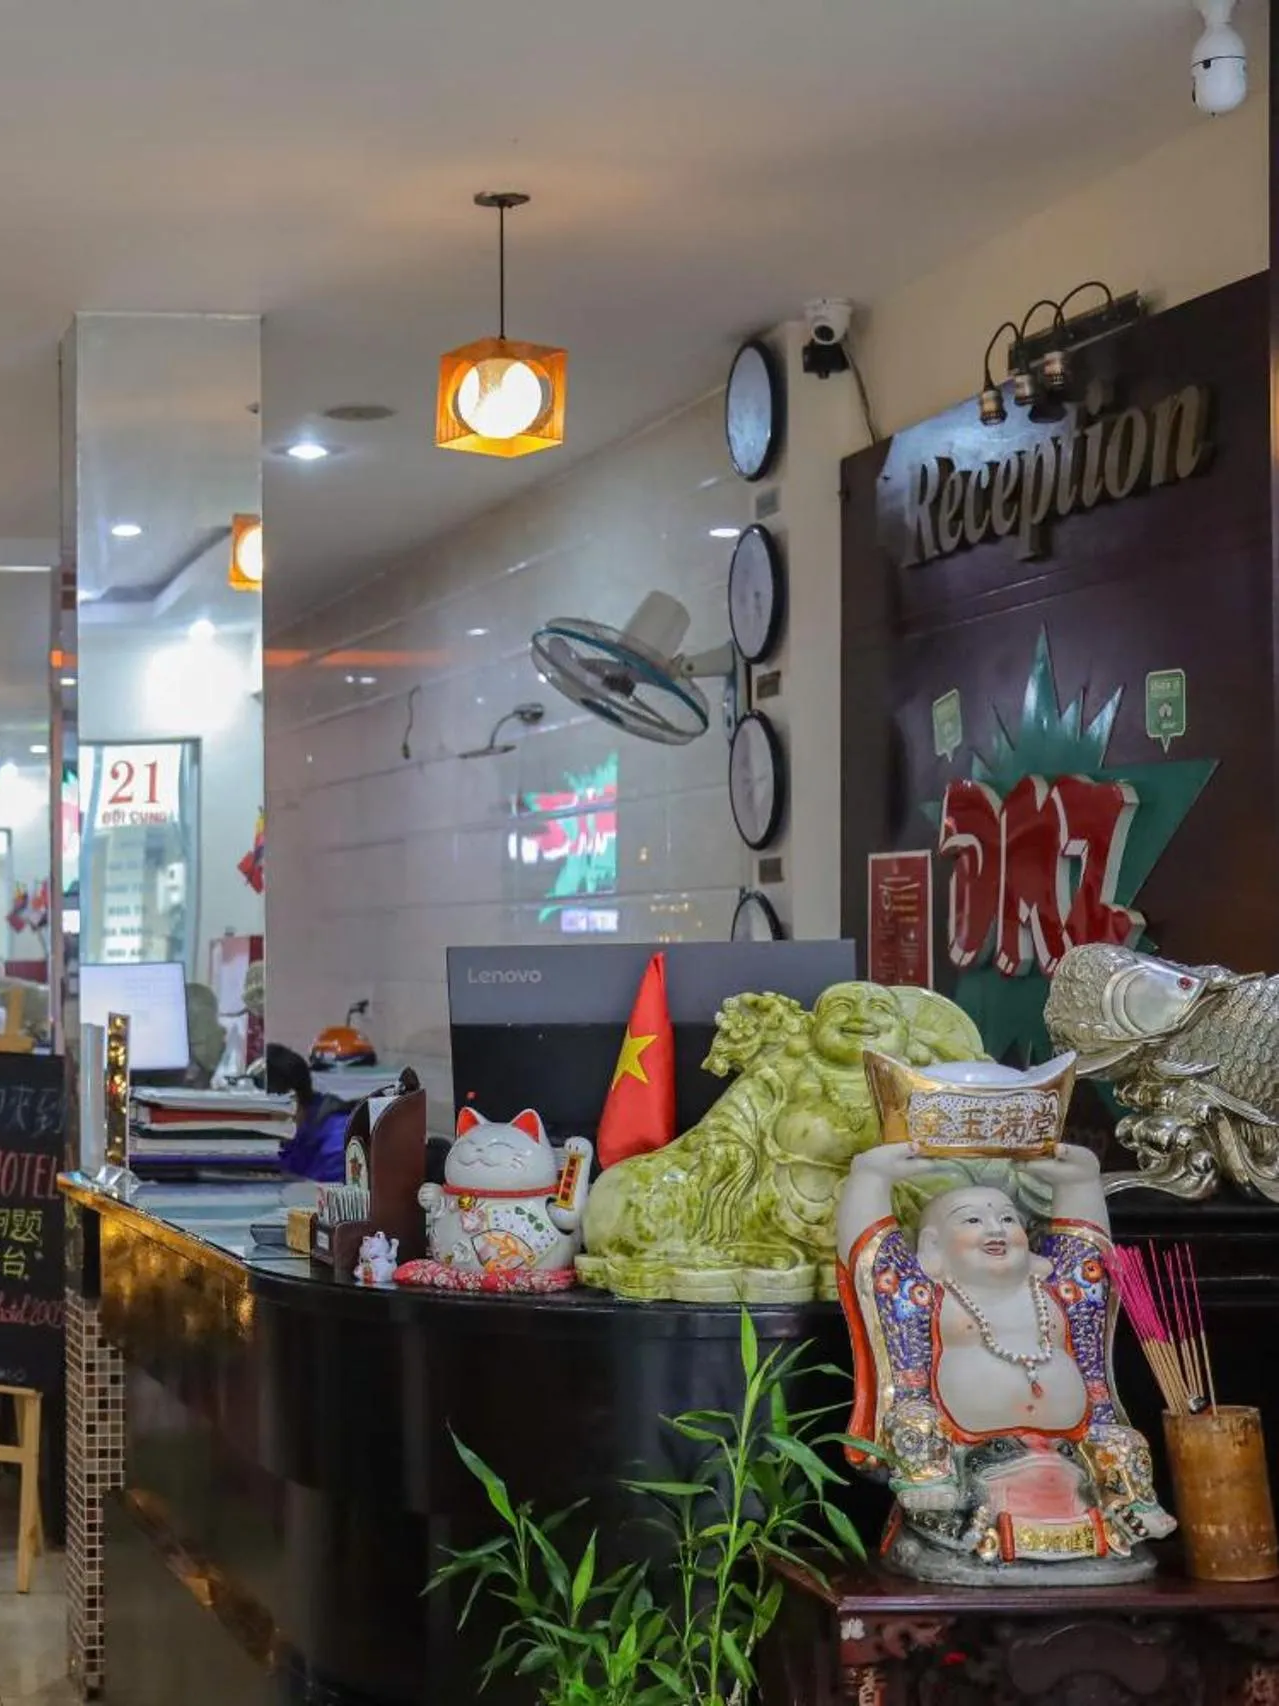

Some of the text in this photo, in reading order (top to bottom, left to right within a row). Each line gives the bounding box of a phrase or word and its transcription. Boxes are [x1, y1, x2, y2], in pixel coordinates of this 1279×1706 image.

[904, 385, 1217, 567] Reception
[108, 760, 160, 804] 21
[939, 774, 1145, 978] DMZ
[468, 967, 542, 984] Lenovo
